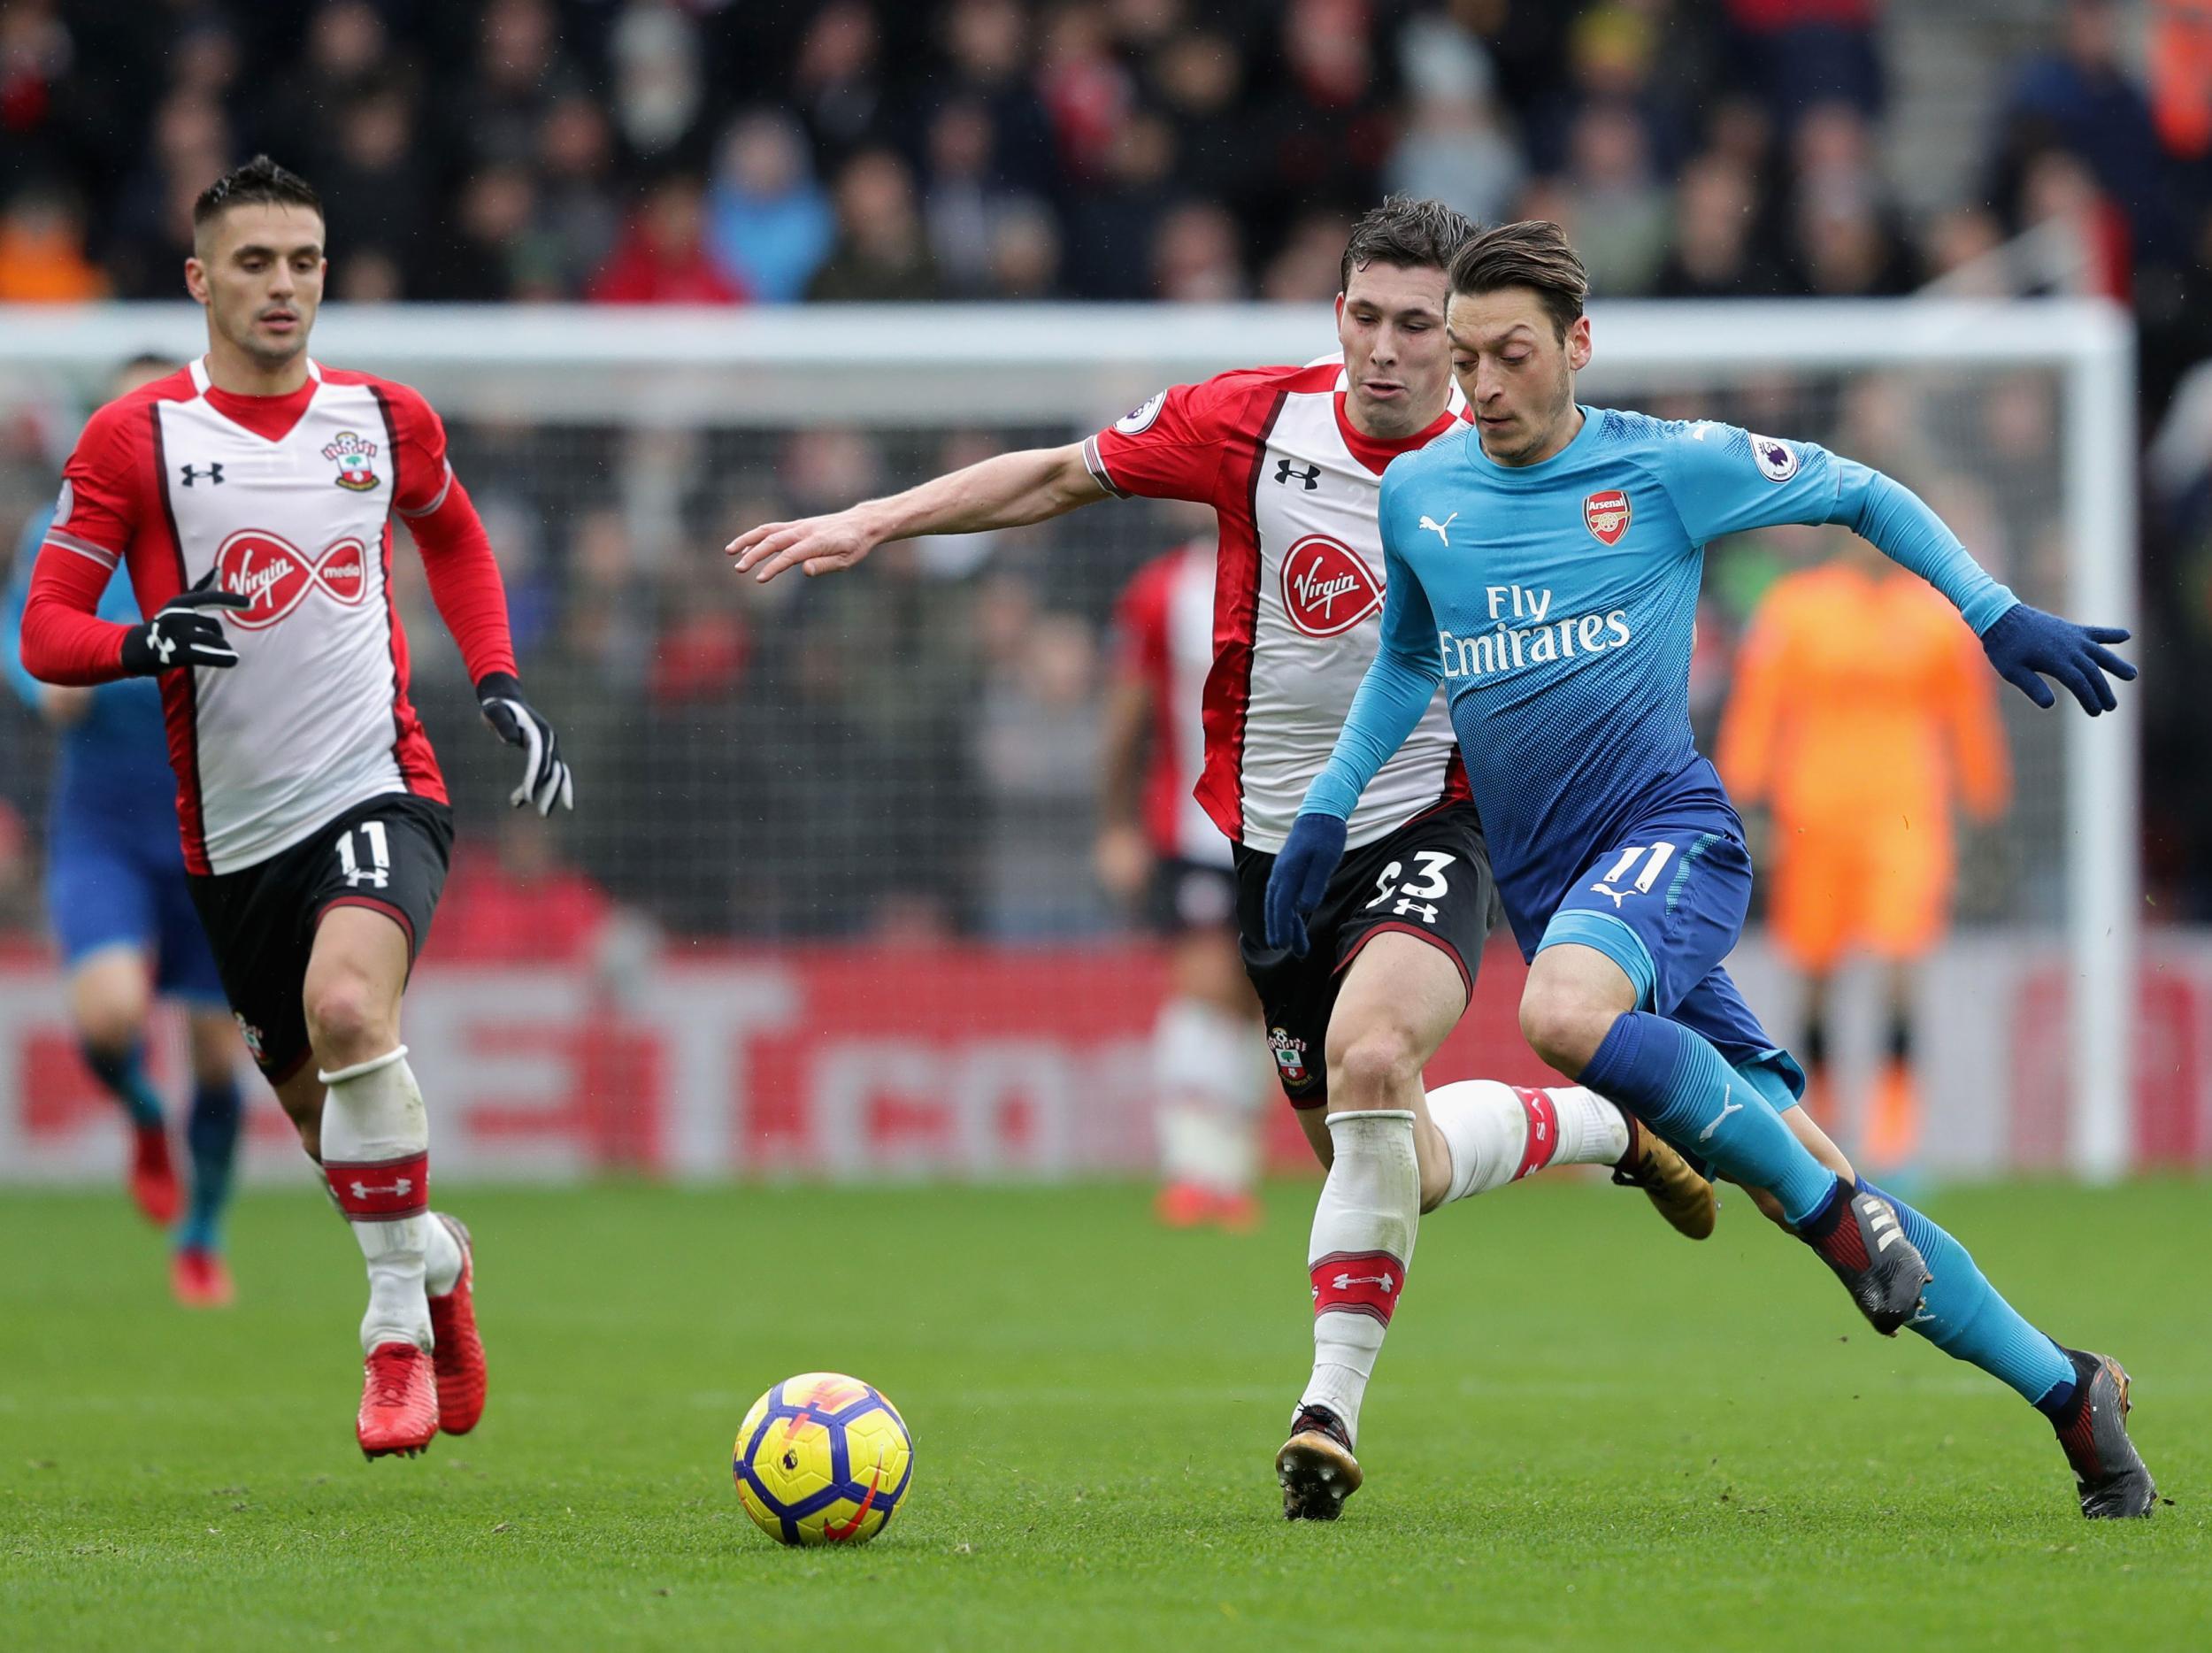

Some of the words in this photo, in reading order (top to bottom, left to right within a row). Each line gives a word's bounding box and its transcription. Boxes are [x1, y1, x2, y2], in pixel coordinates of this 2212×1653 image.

[1589, 497, 1624, 511] Arsenal
[228, 549, 295, 609] Virgin
[323, 562, 360, 579] media
[1294, 556, 1361, 619] Virgin
[1486, 585, 1551, 622] Fly
[1439, 610, 1632, 678] Emirates
[335, 820, 390, 875] 11
[1602, 842, 1676, 895] 11
